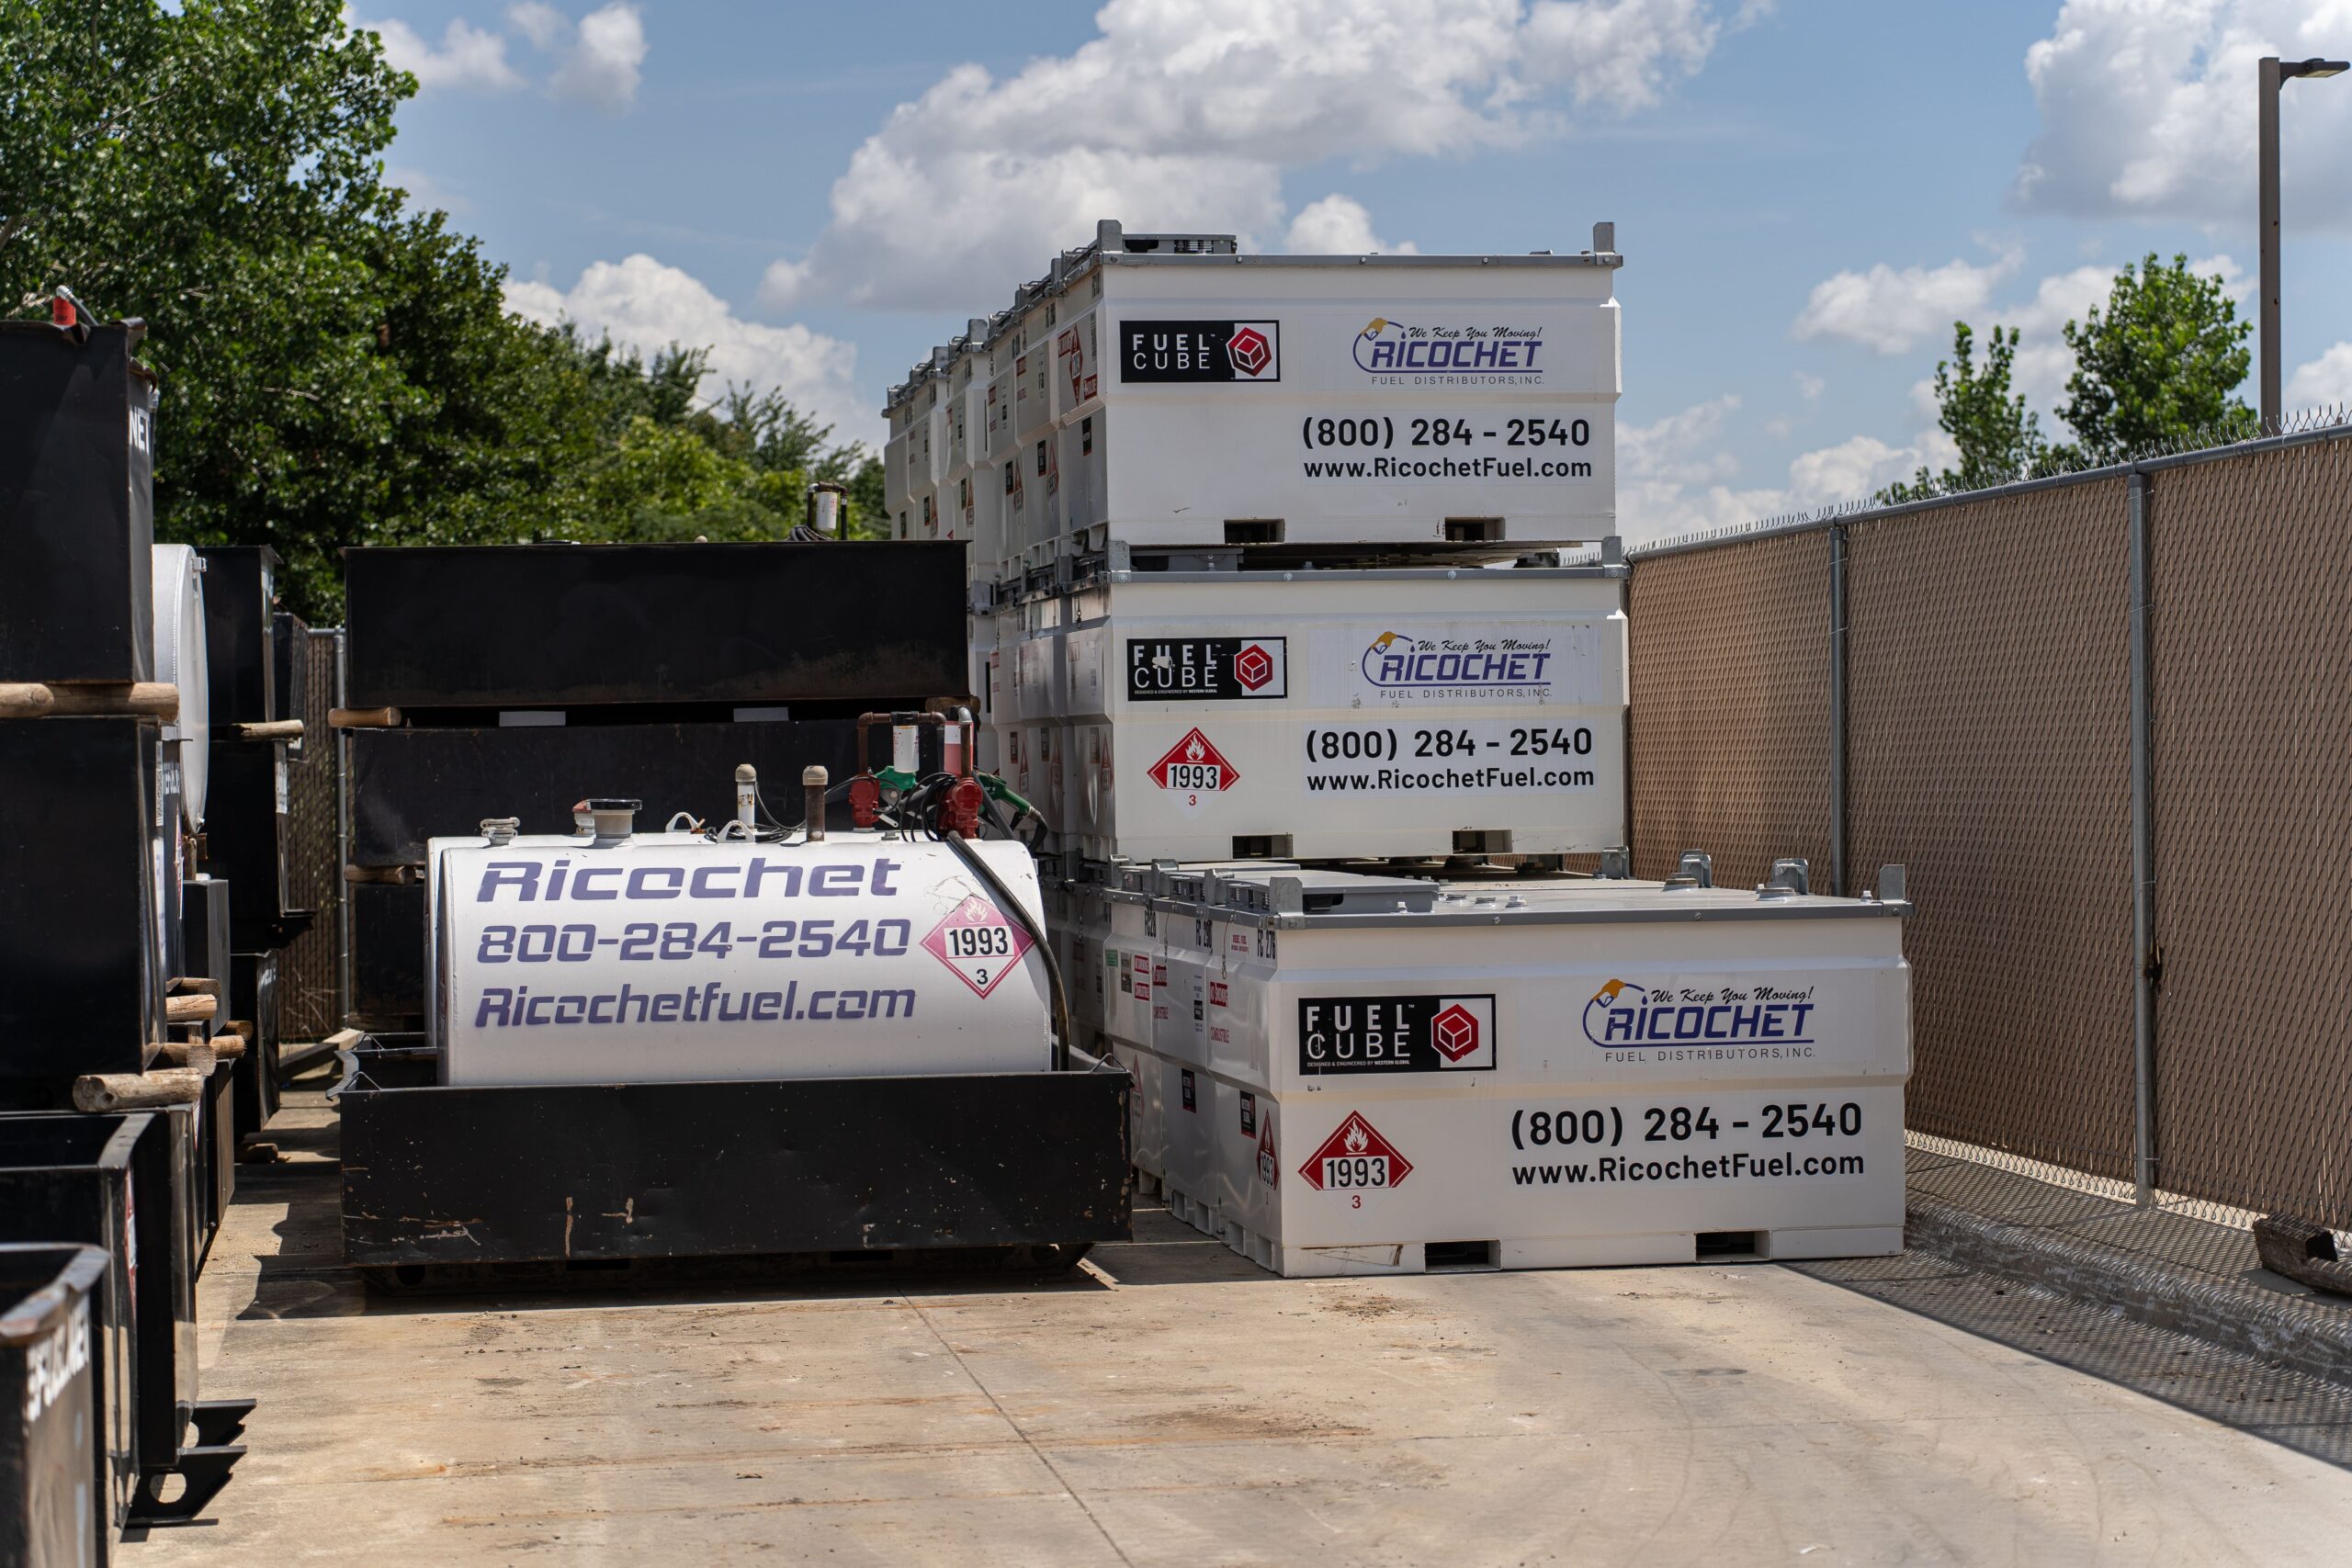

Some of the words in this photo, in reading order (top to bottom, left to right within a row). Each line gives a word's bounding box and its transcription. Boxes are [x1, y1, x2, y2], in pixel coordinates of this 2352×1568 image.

[1133, 333, 1210, 351] FUEL
[1408, 326, 1427, 338] We
[1431, 326, 1461, 340] Keep
[1464, 326, 1487, 341] You
[1492, 326, 1543, 341] Moving!
[1133, 352, 1210, 370] CUBE
[1371, 341, 1543, 368] RICOCHET
[1371, 376, 1405, 386] FUEL
[1303, 416, 1394, 450] (800)
[1410, 418, 1473, 446] 284
[1507, 418, 1589, 446] 2540
[1303, 457, 1592, 479] www.RicochetFuel.com
[1134, 644, 1217, 667] FUEL
[1418, 639, 1436, 651] We
[1441, 639, 1469, 653] Keep
[1473, 639, 1497, 653] You
[1501, 638, 1552, 653] Moving!
[1134, 666, 1218, 689] CUBE
[1380, 653, 1552, 682] RICOCHET
[1380, 689, 1413, 699] FUEL
[1306, 728, 1397, 763] (800)
[1414, 729, 1476, 758] 284
[1510, 728, 1592, 756] 2540
[1170, 764, 1218, 790] 1993
[1306, 767, 1594, 791] www.RicochetFuel.com
[1188, 795, 1197, 807] 3
[476, 857, 902, 903] Ricochet
[476, 919, 911, 964] 800-284-2540
[949, 927, 1008, 956] 1993
[976, 968, 989, 985] 3
[475, 980, 916, 1029] Ricochetfuel.com
[1651, 988, 1674, 1003] We
[1679, 987, 1714, 1005] Keep
[1720, 987, 1747, 1005] You
[1753, 986, 1815, 1004] Moving!
[1306, 1004, 1410, 1032] FUEL
[1604, 1004, 1815, 1042] RICOCHET
[1307, 1032, 1411, 1060] CUBE
[1605, 1050, 1645, 1063] FUEL
[1511, 1106, 1623, 1150] (800)
[1644, 1106, 1720, 1142] 284
[1761, 1102, 1862, 1138] 2540
[1326, 1159, 1386, 1187] 1993
[1511, 1151, 1865, 1186] www.RicochetFuel.com
[1351, 1195, 1362, 1209] 3
